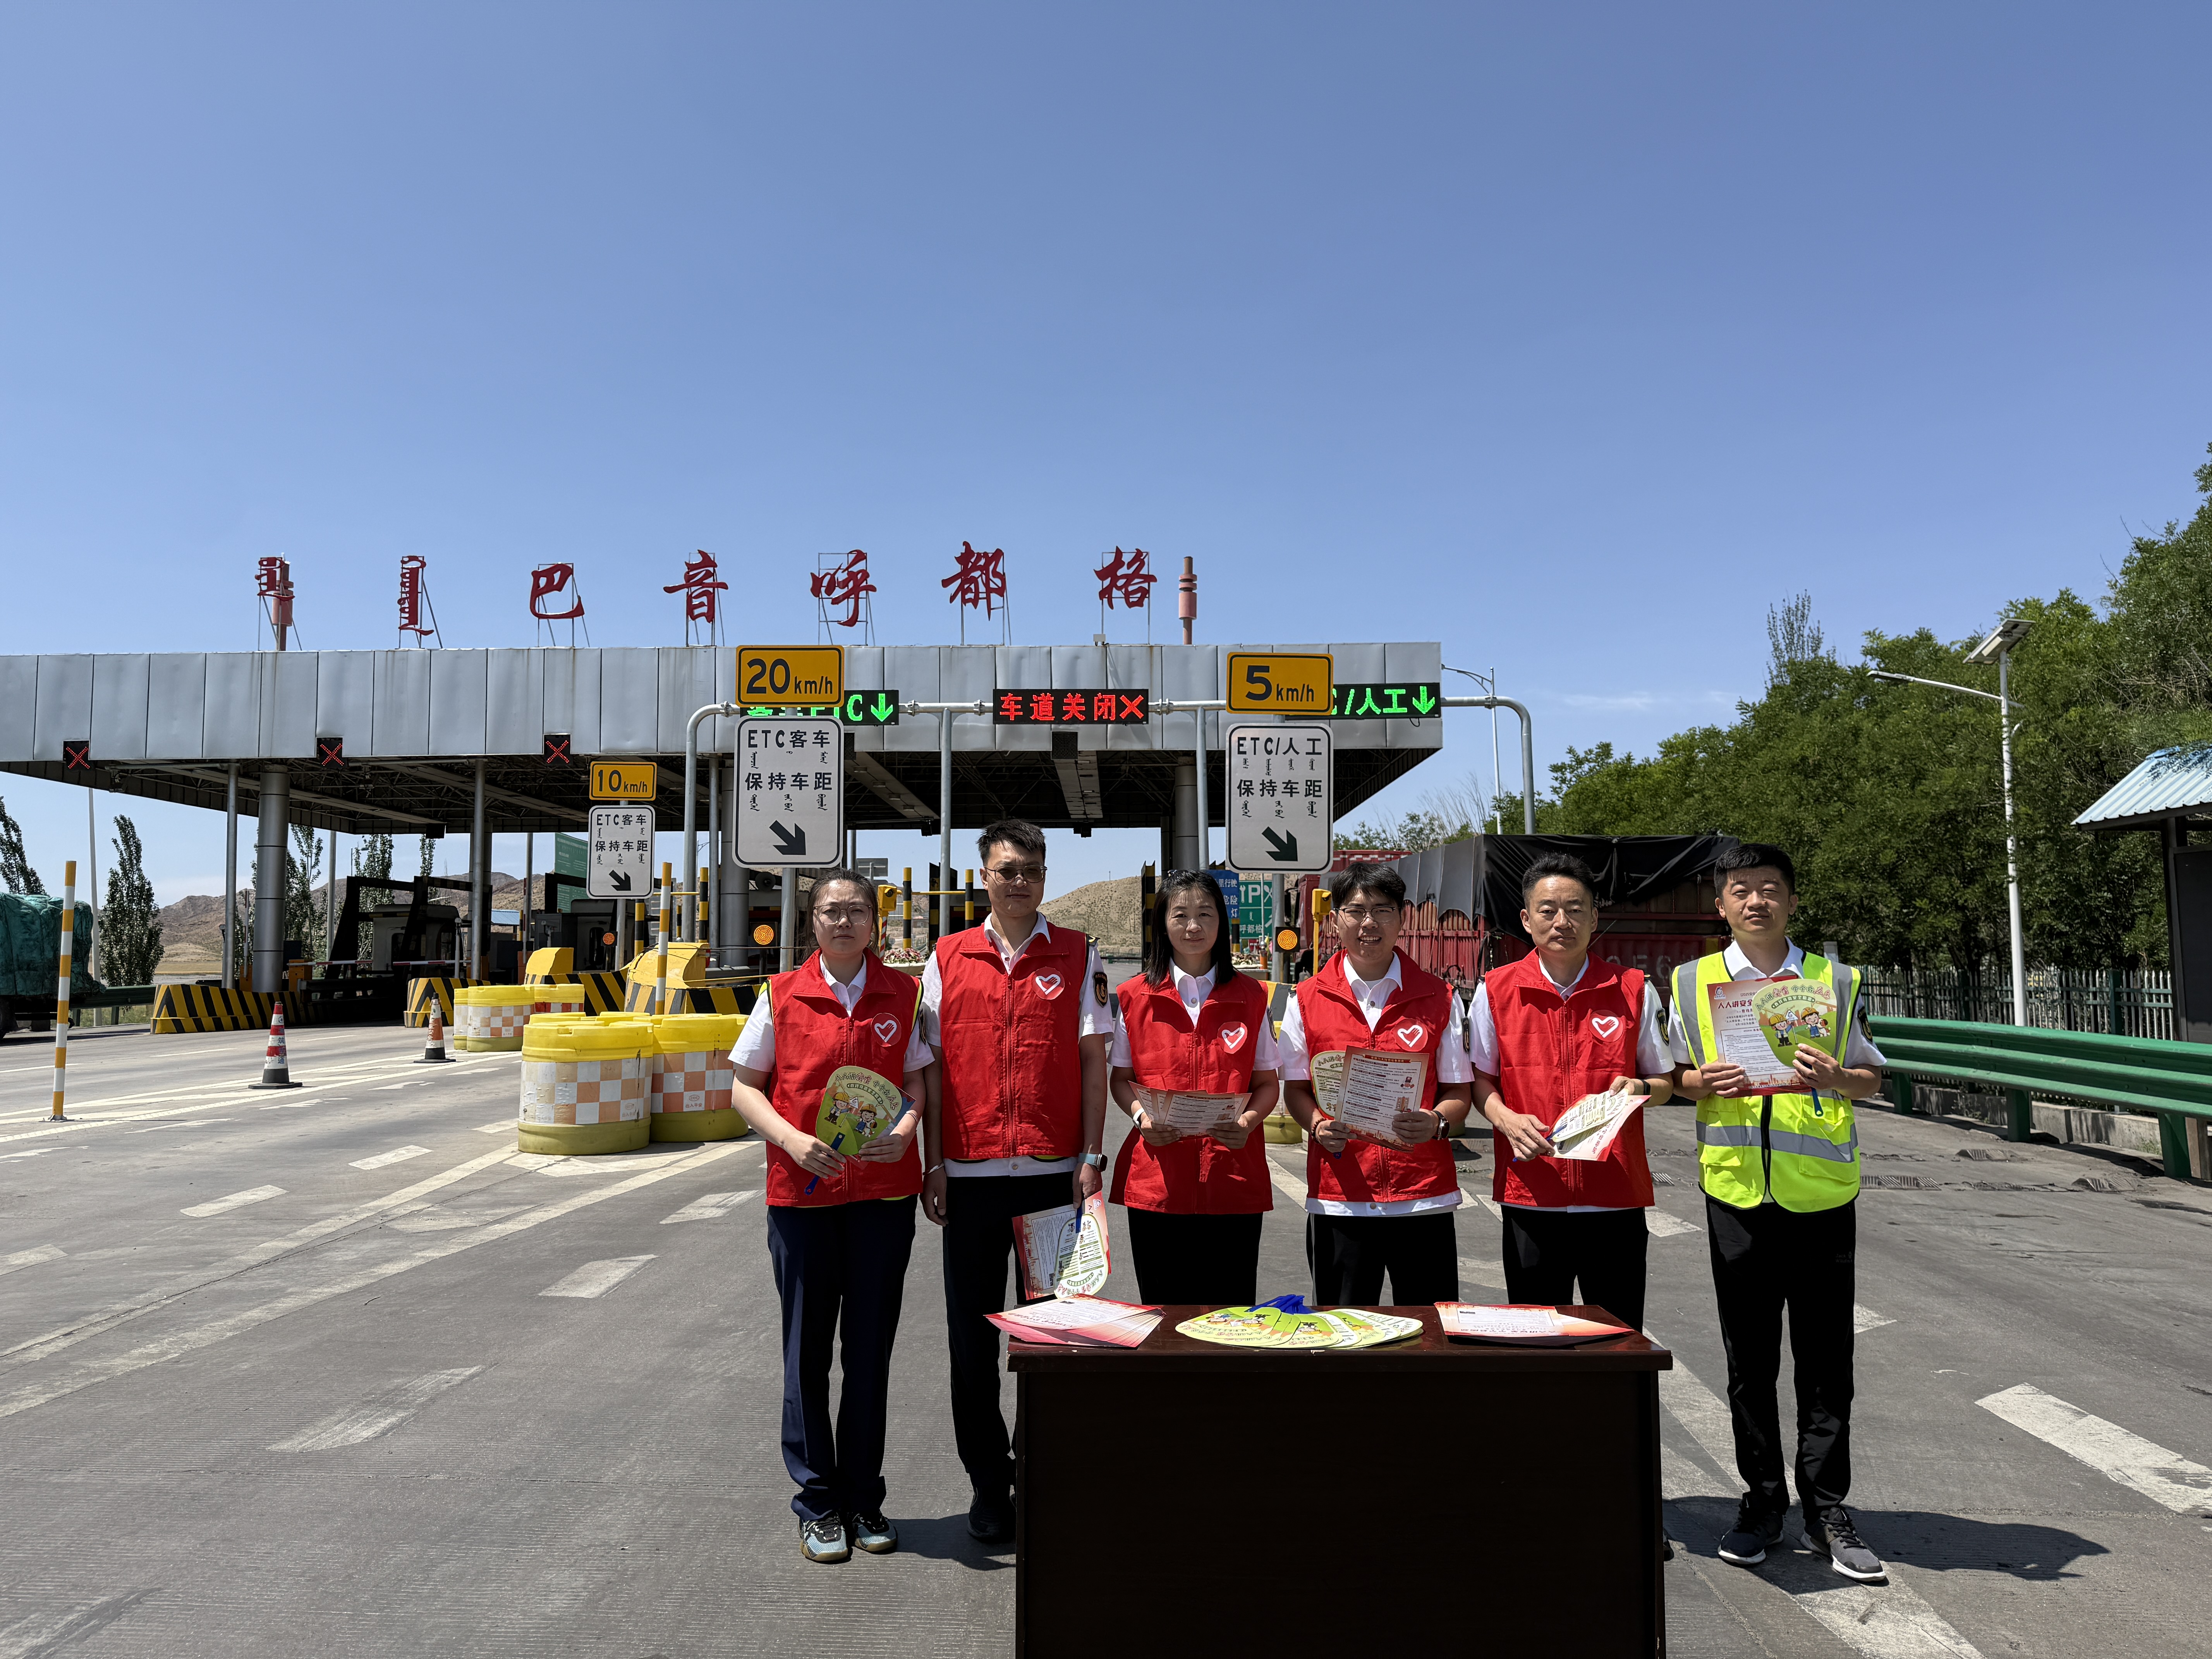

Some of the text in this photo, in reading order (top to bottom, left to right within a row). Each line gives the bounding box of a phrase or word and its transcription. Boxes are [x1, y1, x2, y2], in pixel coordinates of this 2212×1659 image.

[529, 542, 1158, 627] 巴音呼都格
[999, 693, 1116, 721] 车道关闭
[745, 772, 833, 791] 保持车距
[1237, 779, 1322, 798] 保持车距
[595, 840, 648, 852] 保持车距
[1216, 878, 1238, 888] 里行驶
